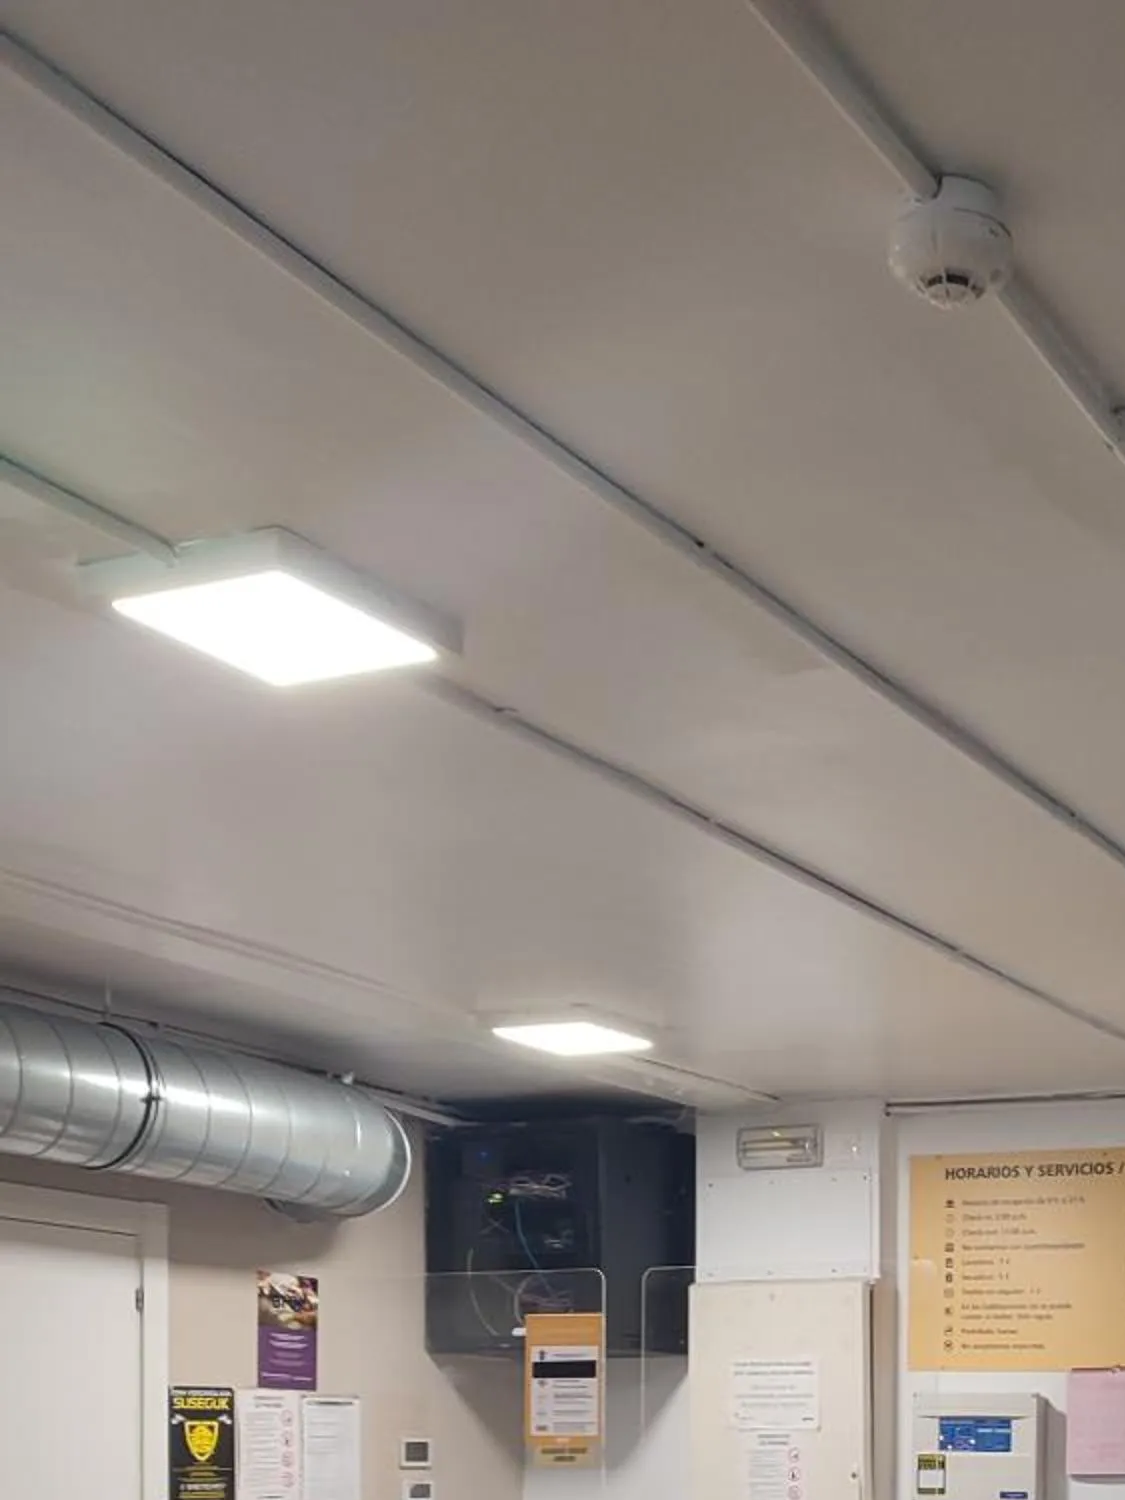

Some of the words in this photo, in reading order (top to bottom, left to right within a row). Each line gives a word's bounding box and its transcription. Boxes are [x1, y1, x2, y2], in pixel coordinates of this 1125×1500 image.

[945, 1166, 1020, 1180] HORARIOS
[1025, 1166, 1035, 1178] Y
[1039, 1161, 1114, 1176] SERVICIOS
